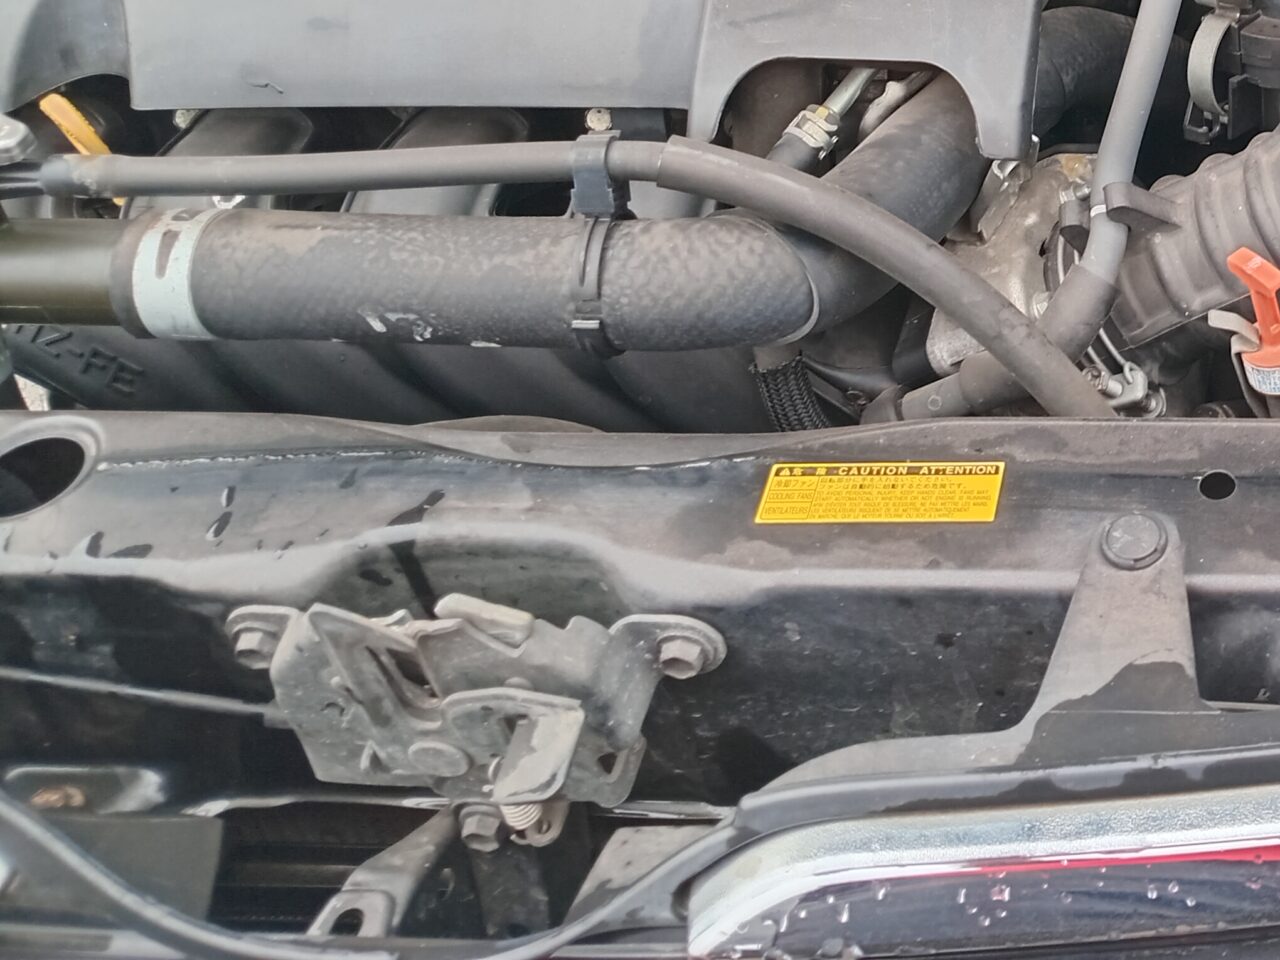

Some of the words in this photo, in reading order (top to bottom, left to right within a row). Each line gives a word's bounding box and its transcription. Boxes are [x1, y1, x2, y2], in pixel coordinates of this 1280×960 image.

[838, 466, 908, 475] CAUTION
[919, 465, 996, 475] ATTENTION
[797, 492, 813, 500] FANS
